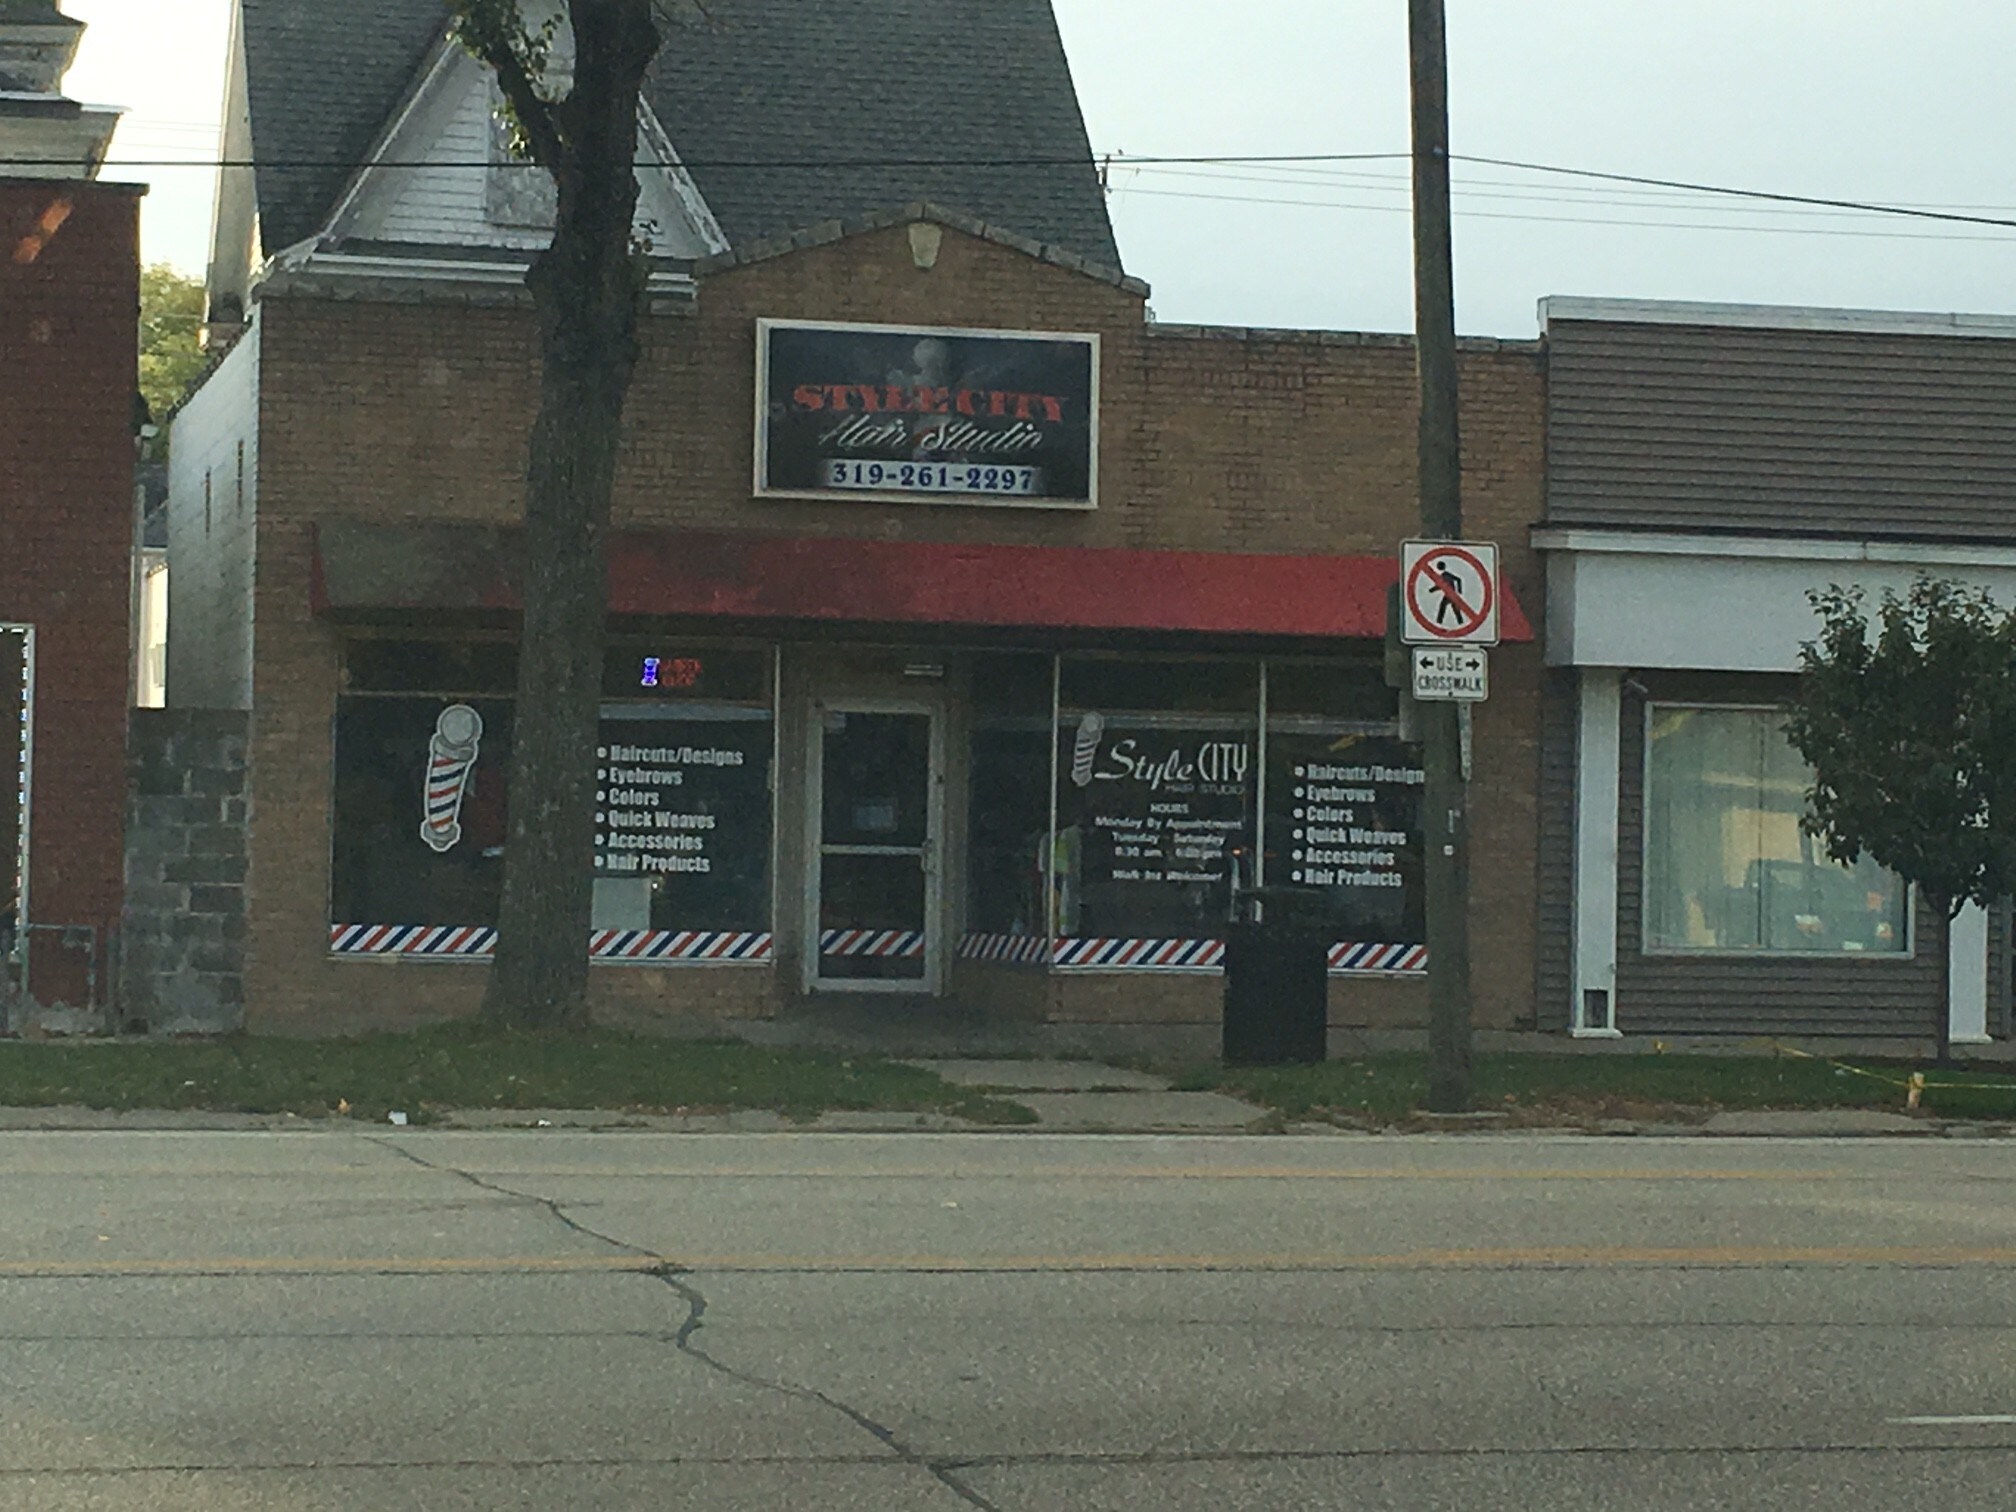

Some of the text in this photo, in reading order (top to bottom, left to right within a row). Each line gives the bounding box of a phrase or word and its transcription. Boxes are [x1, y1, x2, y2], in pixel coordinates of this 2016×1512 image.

[793, 384, 1068, 422] STYLE CITY
[818, 413, 1043, 453] Hair Studio
[833, 462, 1032, 491] 319-261-2297
[1436, 655, 1463, 672] USE
[1418, 675, 1483, 692] CROSSWALK
[610, 745, 743, 767] Haircuts/Designs
[1094, 739, 1248, 790] Style CITY
[609, 767, 683, 785] Eyebrows
[1307, 763, 1425, 784] Haircuts/Design
[609, 788, 660, 806] Colors
[1306, 784, 1376, 802] Eyebrows
[1150, 803, 1189, 814] HOURS
[1306, 805, 1354, 823] Colors
[608, 809, 715, 830] Quick Weaves
[608, 832, 703, 851] Accessories
[1306, 826, 1407, 845] Quick Weaves
[607, 853, 710, 873] Hair Products
[1306, 847, 1395, 866] Accessories
[1305, 868, 1402, 887] Hair Products
